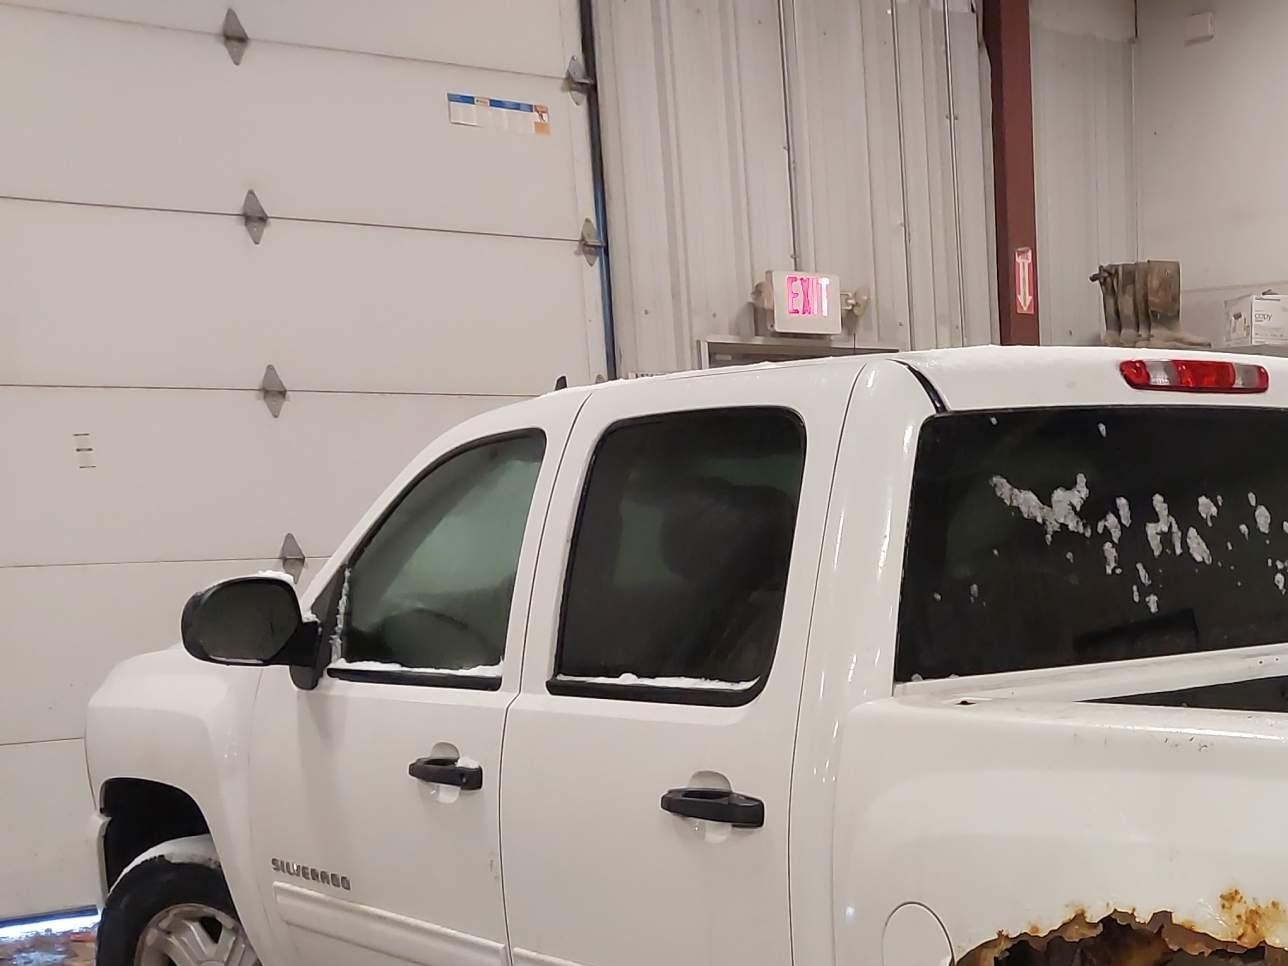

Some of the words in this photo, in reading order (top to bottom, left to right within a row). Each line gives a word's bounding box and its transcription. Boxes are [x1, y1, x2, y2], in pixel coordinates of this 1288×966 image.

[786, 275, 830, 317] EXIT
[1254, 312, 1273, 321] copy
[271, 857, 351, 891] SILVERADO
